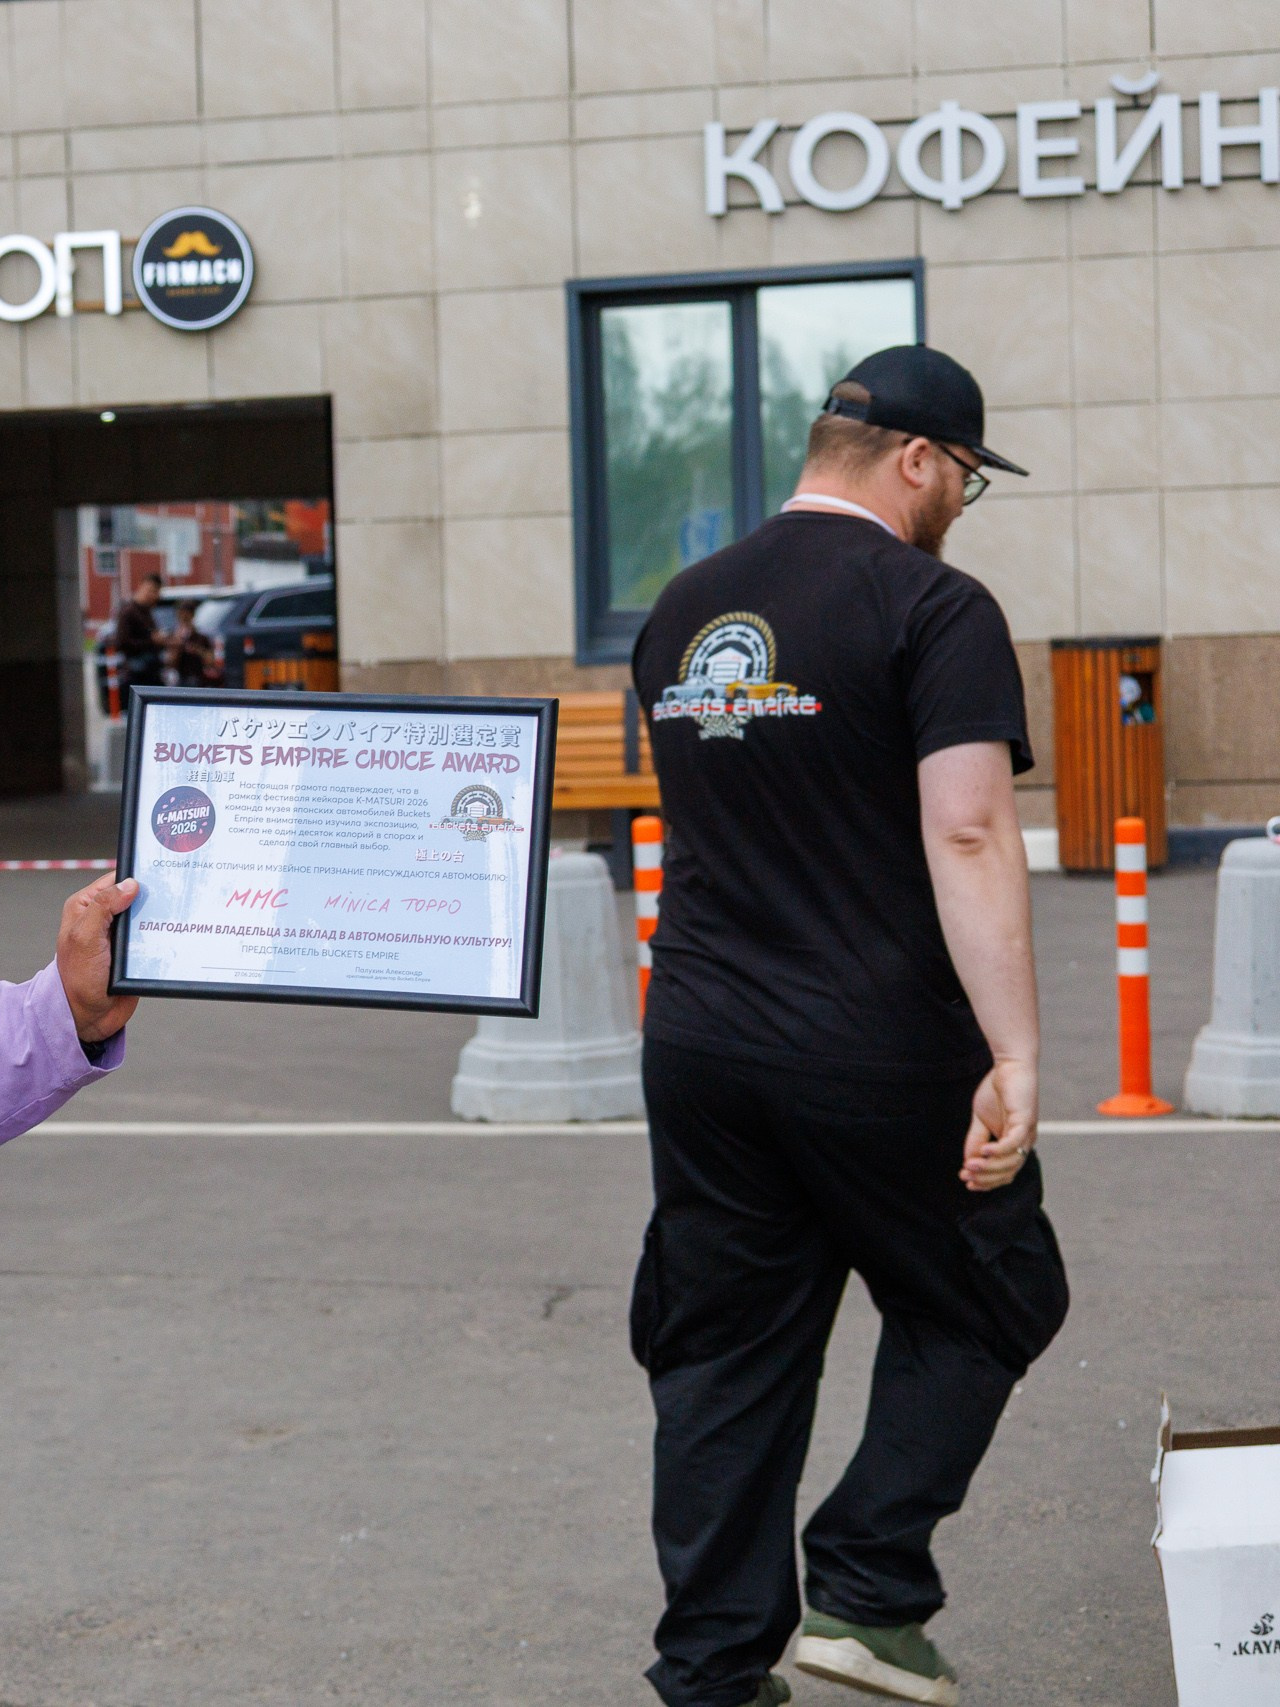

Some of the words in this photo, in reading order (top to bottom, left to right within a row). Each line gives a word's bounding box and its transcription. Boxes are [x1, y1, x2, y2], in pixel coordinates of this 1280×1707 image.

[703, 71, 1280, 216] КОФЕЙН
[216, 717, 522, 748] バケツエンパイア特別選定賞
[153, 742, 253, 766] BUCKETS
[261, 746, 349, 769] EMPIRE
[355, 748, 436, 772] CHOICE
[441, 751, 520, 774] AWARD
[239, 781, 289, 791] Настоящая
[291, 784, 327, 793] грамота
[330, 785, 394, 795] подтверждает,
[228, 793, 261, 802] рамках
[264, 793, 309, 803] фестиваля
[312, 795, 354, 805] кейкаров
[356, 797, 405, 806] K-MATSURI
[407, 798, 428, 807] 2026
[157, 805, 210, 825] K-MATSURI
[225, 804, 263, 813] команда
[265, 806, 291, 814] музея
[293, 807, 333, 815] японских
[336, 807, 395, 817] автомобилей
[397, 809, 431, 818] Buckets
[170, 820, 197, 837] 2026
[234, 815, 264, 825] Empire
[266, 818, 322, 826] внимательно
[325, 820, 361, 829] изучила
[363, 821, 419, 830] экспозицию,
[274, 829, 297, 837] один
[299, 830, 334, 838] десяток
[336, 831, 374, 841] калорий
[384, 833, 415, 842] спорах
[259, 840, 295, 848] сделала
[298, 839, 319, 848] свой
[321, 840, 358, 849] главный
[360, 842, 391, 851] выбор.
[152, 859, 190, 869] ОСОБЫЙ
[192, 861, 214, 870] ЗНАК
[216, 862, 255, 871] ОТЛИЧИЯ
[265, 863, 311, 874] МУЗЕЙНОЕ
[313, 866, 365, 876] ПРИЗНАНИЕ
[367, 868, 440, 880] ПРИСУЖДАЮТСЯ
[442, 872, 508, 882] АВТОМОБИЛЮ:
[225, 888, 289, 910] MMC
[401, 898, 462, 914] TOPPO
[138, 921, 213, 934] БЛАГОДАРИМ
[215, 925, 281, 939] ВЛАДЕЛЬЦА
[283, 928, 297, 938] ЗА
[299, 929, 336, 941] ВКЛАД
[339, 931, 346, 940] В
[348, 931, 451, 945] АВТОМОБИЛЬНУЮ
[453, 935, 512, 948] КУЛЬТУРУ!
[241, 945, 320, 957] ПРЕДСТАВИТЕЛЬ
[322, 949, 363, 959] BUCKETS
[365, 950, 400, 960] EMPIRE
[385, 968, 422, 977] Александр
